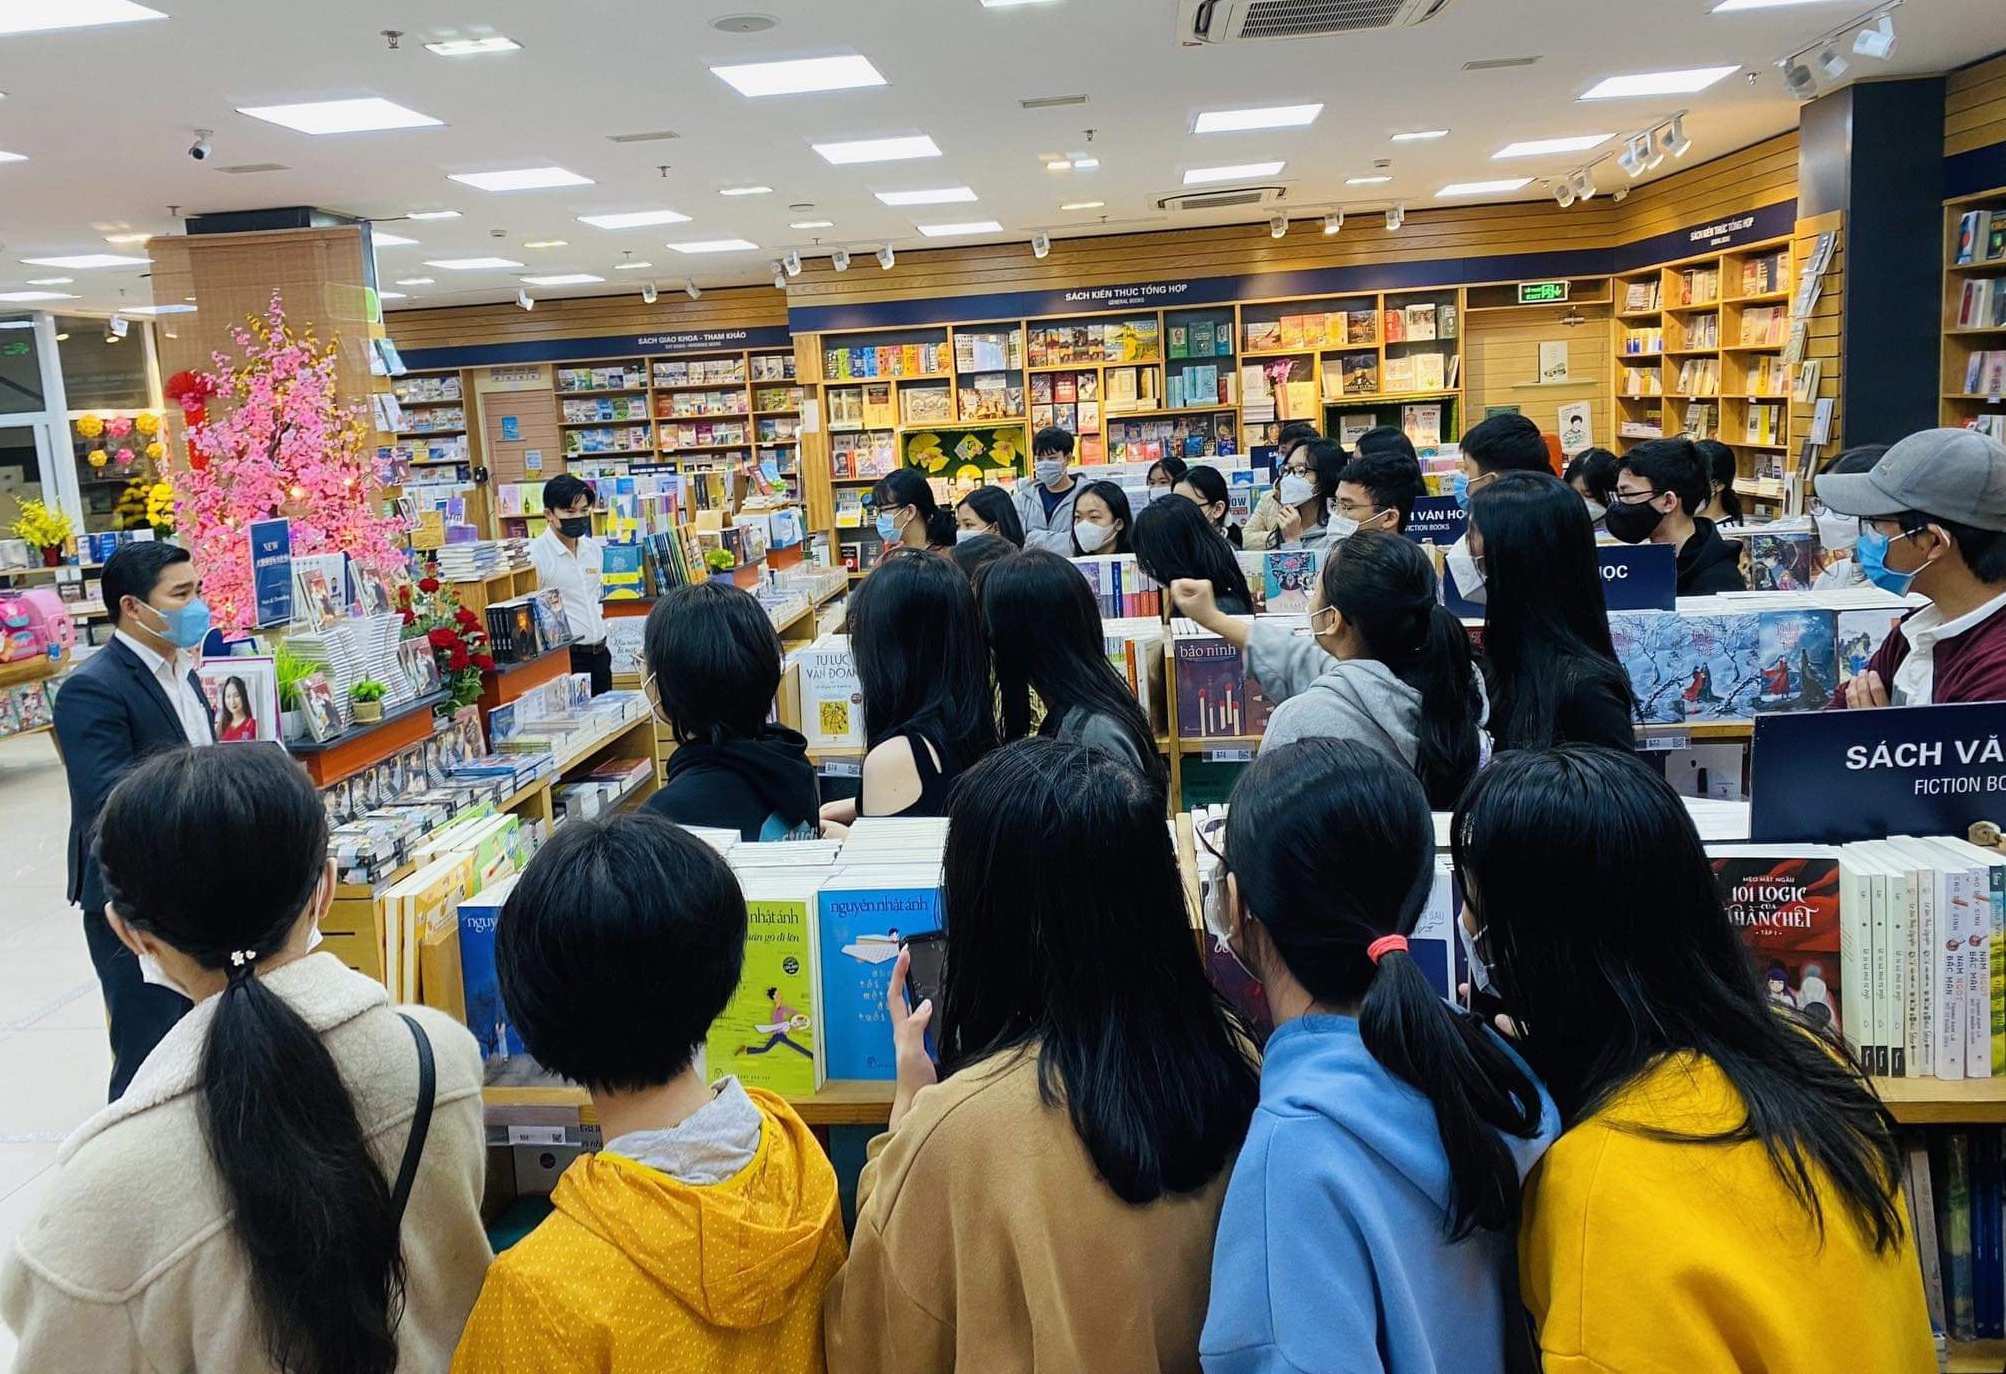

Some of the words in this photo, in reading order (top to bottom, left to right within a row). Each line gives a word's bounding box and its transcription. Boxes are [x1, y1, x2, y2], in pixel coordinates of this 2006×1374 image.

[1447, 509, 1468, 521] HỌ
[1845, 740, 1943, 770] SÁCH
[1954, 734, 2005, 765] VĂ
[1914, 776, 1981, 795] FICTION
[1732, 886, 1754, 902] 101
[1759, 886, 1807, 904] LOGIC
[467, 917, 496, 934] nguy
[750, 907, 776, 926] nhật
[776, 907, 799, 924] ánh
